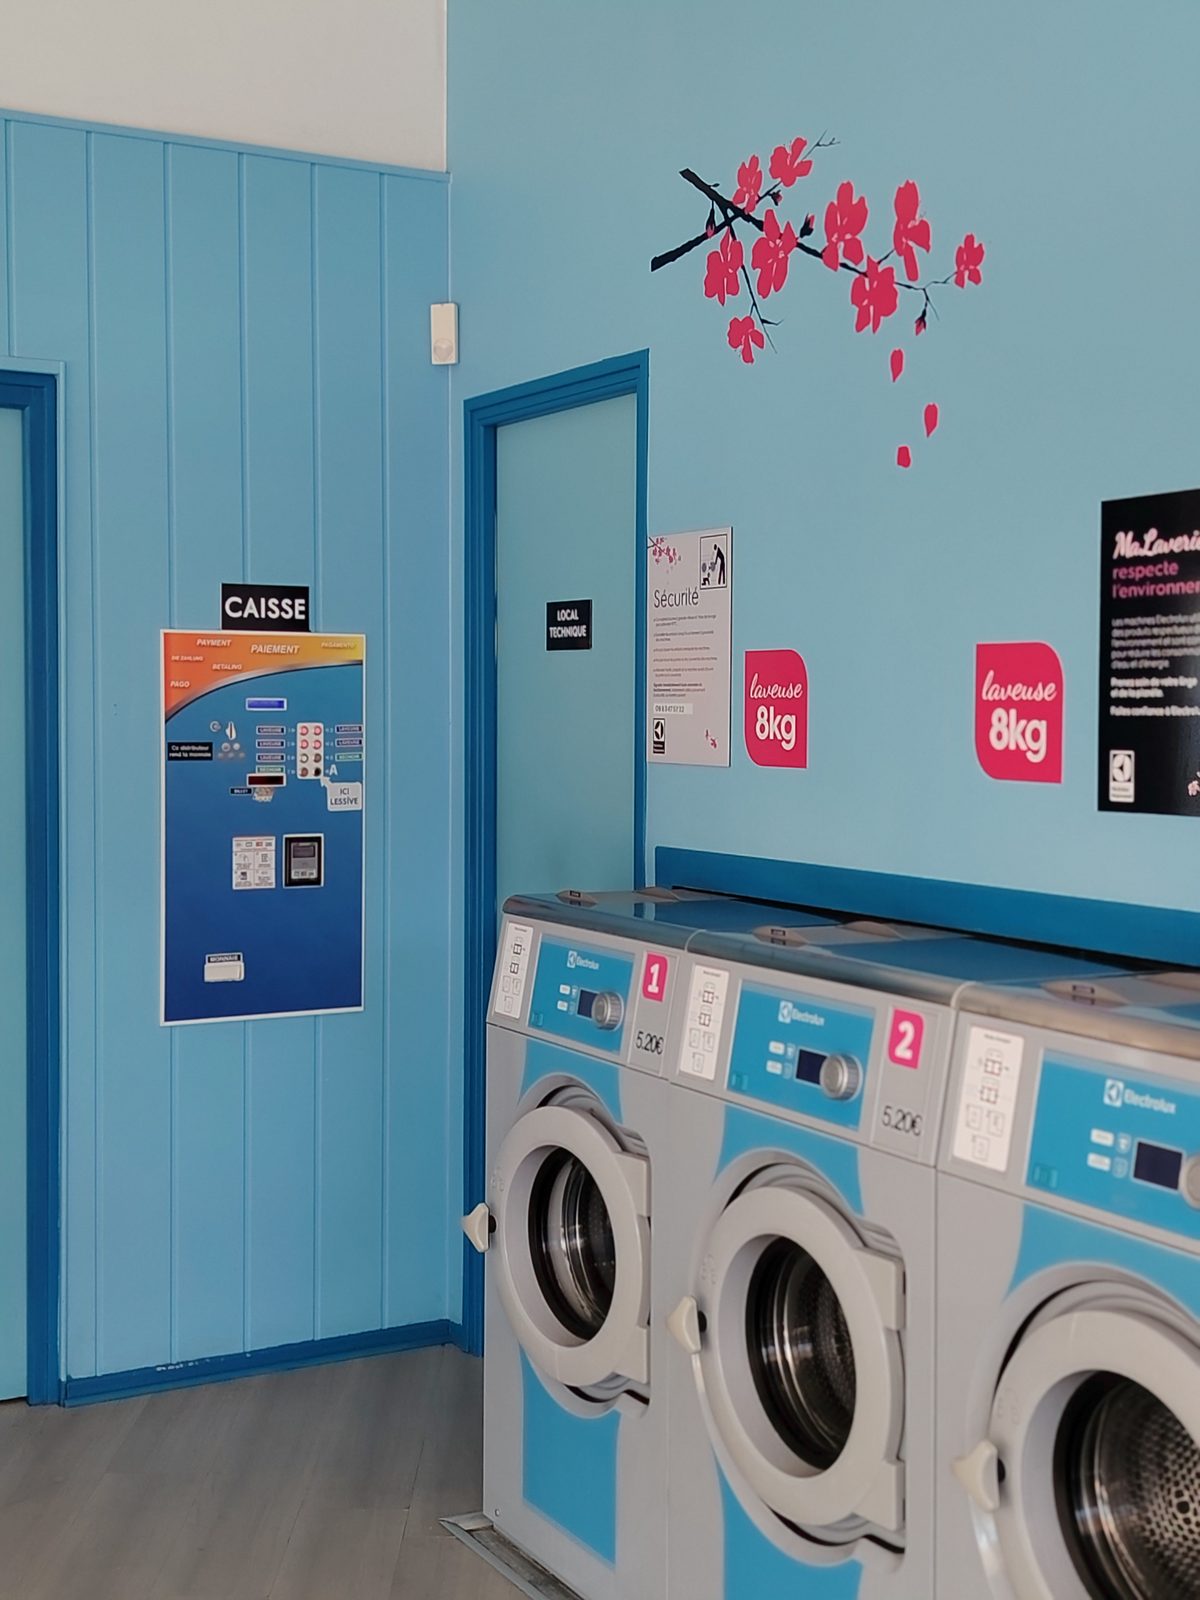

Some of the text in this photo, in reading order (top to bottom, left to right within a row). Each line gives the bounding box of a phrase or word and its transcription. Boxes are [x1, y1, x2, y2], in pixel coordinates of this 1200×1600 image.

[1112, 562, 1178, 581] respecte
[653, 586, 699, 608] Sécurité
[224, 596, 306, 620] CAISSE
[557, 609, 579, 621] LOCAL
[549, 625, 587, 639] TECHNIQUE
[196, 638, 232, 648] PAYMENT
[251, 644, 300, 655] PAIEMENT
[213, 663, 243, 671] BETALING
[170, 680, 191, 690] PAGO
[750, 673, 803, 700] laveuse
[981, 669, 1057, 701] laveuse
[755, 705, 796, 751] 8kg
[989, 707, 1048, 763] 8kg
[329, 763, 338, 775] A
[340, 787, 350, 795] ICI
[577, 955, 600, 970] Electrolux
[647, 962, 660, 994] 1
[791, 1008, 825, 1026] Electrolux
[635, 1030, 664, 1055] 5.20€
[894, 1020, 915, 1060] 2
[1123, 1088, 1176, 1115] Electrolux
[881, 1105, 922, 1136] 5.20€
